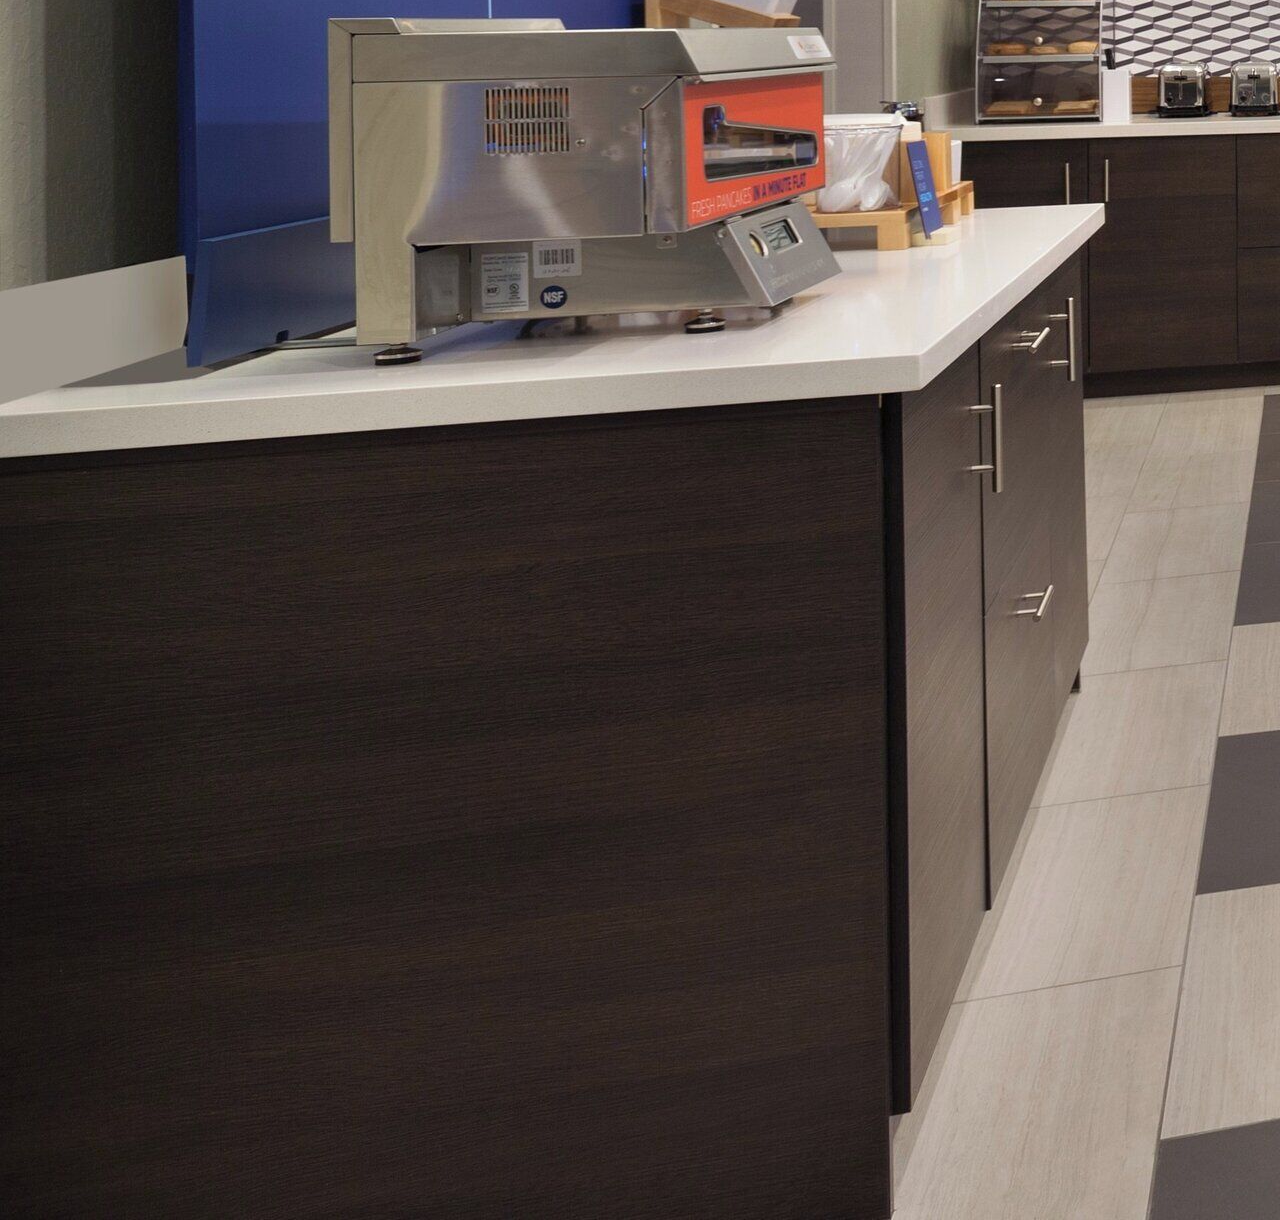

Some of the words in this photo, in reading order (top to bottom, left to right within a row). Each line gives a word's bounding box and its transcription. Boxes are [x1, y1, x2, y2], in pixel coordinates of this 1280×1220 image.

[691, 197, 716, 219] FRESH
[716, 187, 753, 211] PANCAKES
[753, 184, 761, 201] IN
[768, 176, 792, 195] MINUTE
[793, 172, 807, 189] FLAT
[543, 291, 565, 304] NSF
